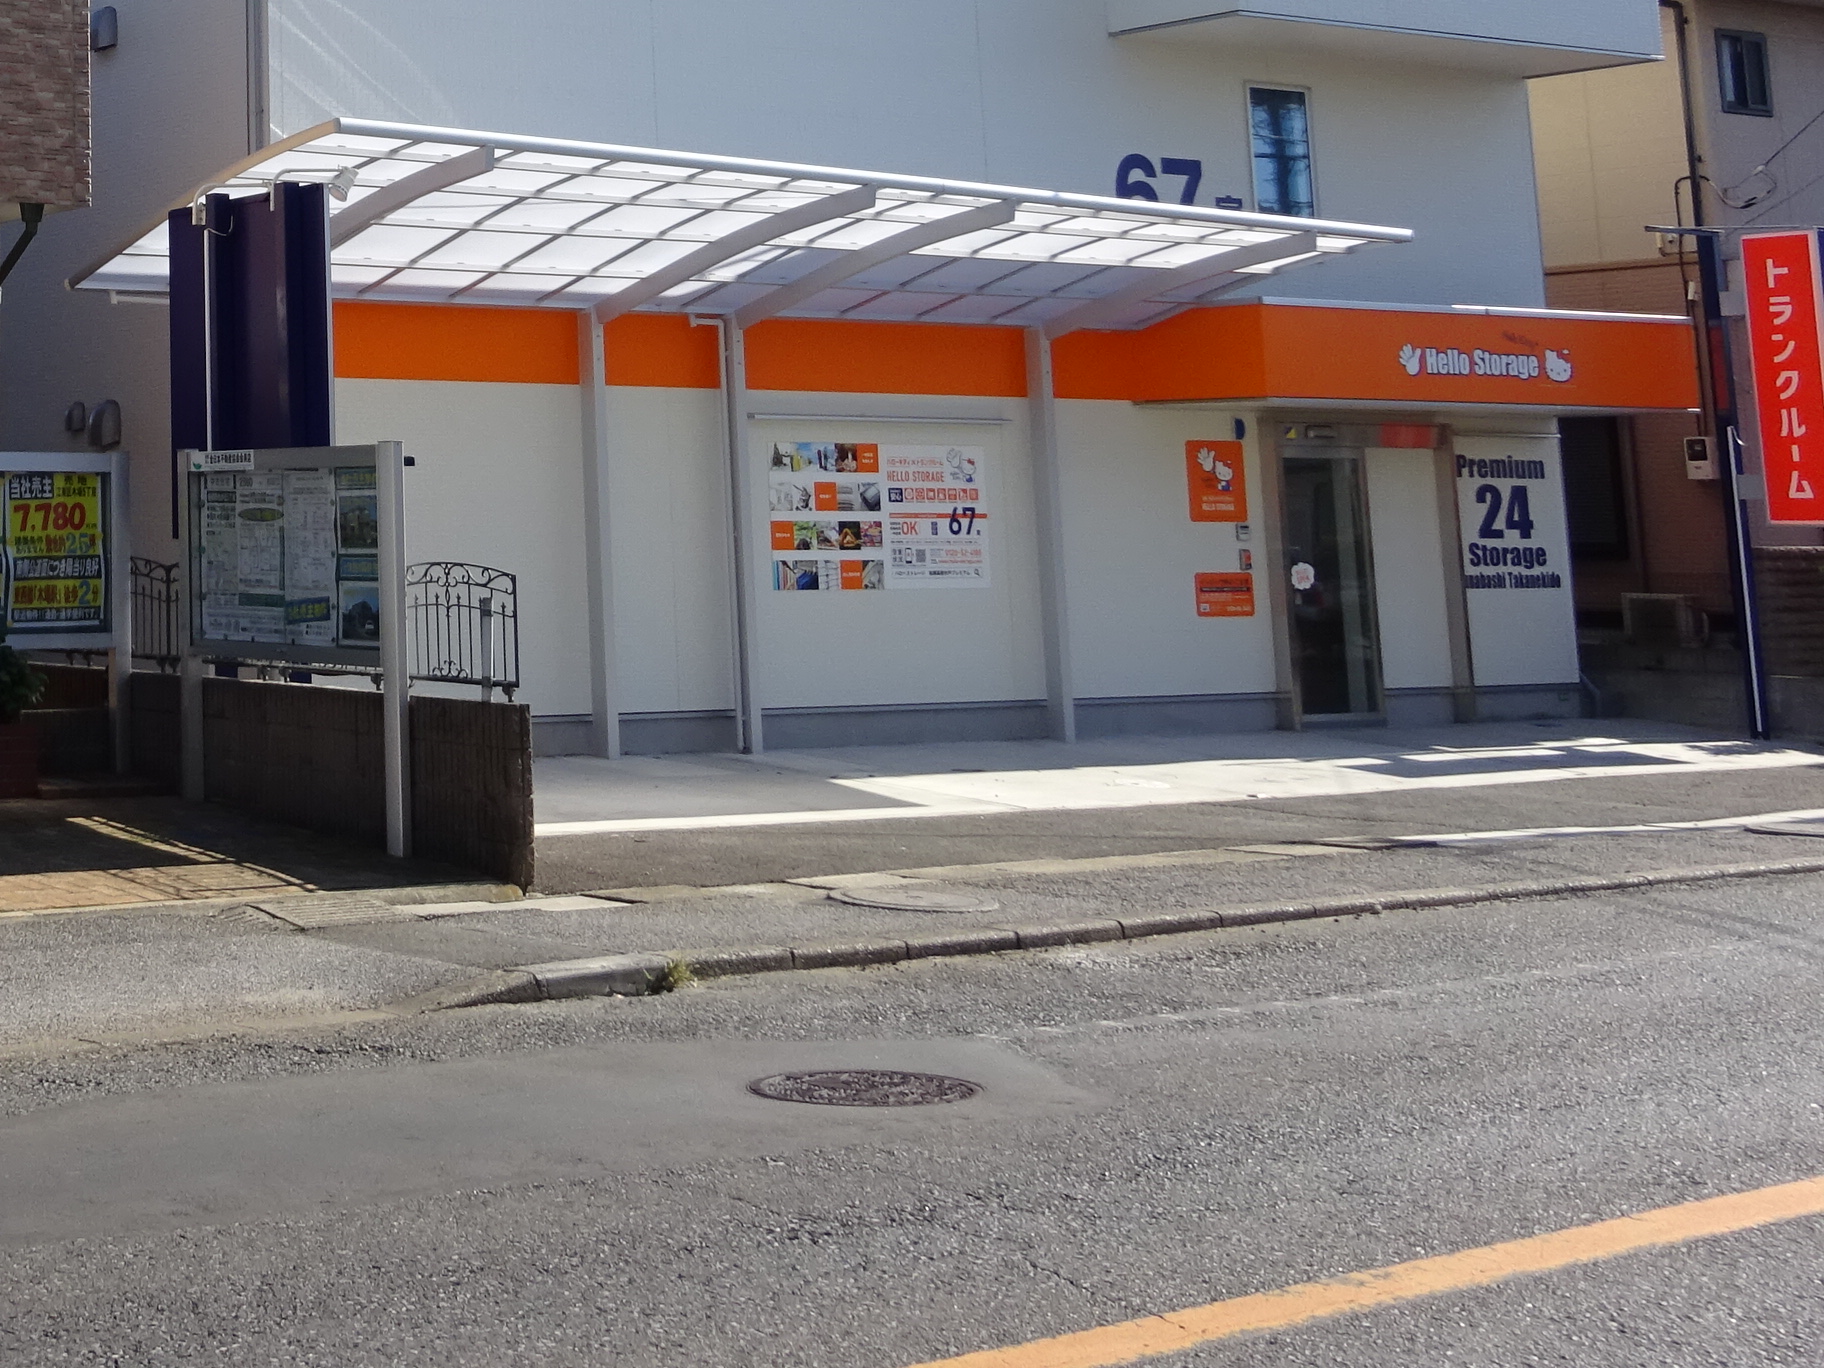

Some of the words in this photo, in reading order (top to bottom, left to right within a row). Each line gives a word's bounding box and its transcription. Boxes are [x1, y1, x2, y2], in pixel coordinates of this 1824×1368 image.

[1425, 347, 1470, 375] Hello
[1473, 348, 1539, 379] Storage
[1764, 258, 1814, 499] トランクルーム
[887, 470, 909, 482] HELLO
[912, 471, 944, 483] STORAGE
[1456, 454, 1545, 479] Premium
[10, 475, 53, 498] 当社売主
[949, 506, 976, 535] 67
[1476, 484, 1534, 539] 24
[901, 521, 919, 535] OK
[1468, 542, 1547, 569] Storage
